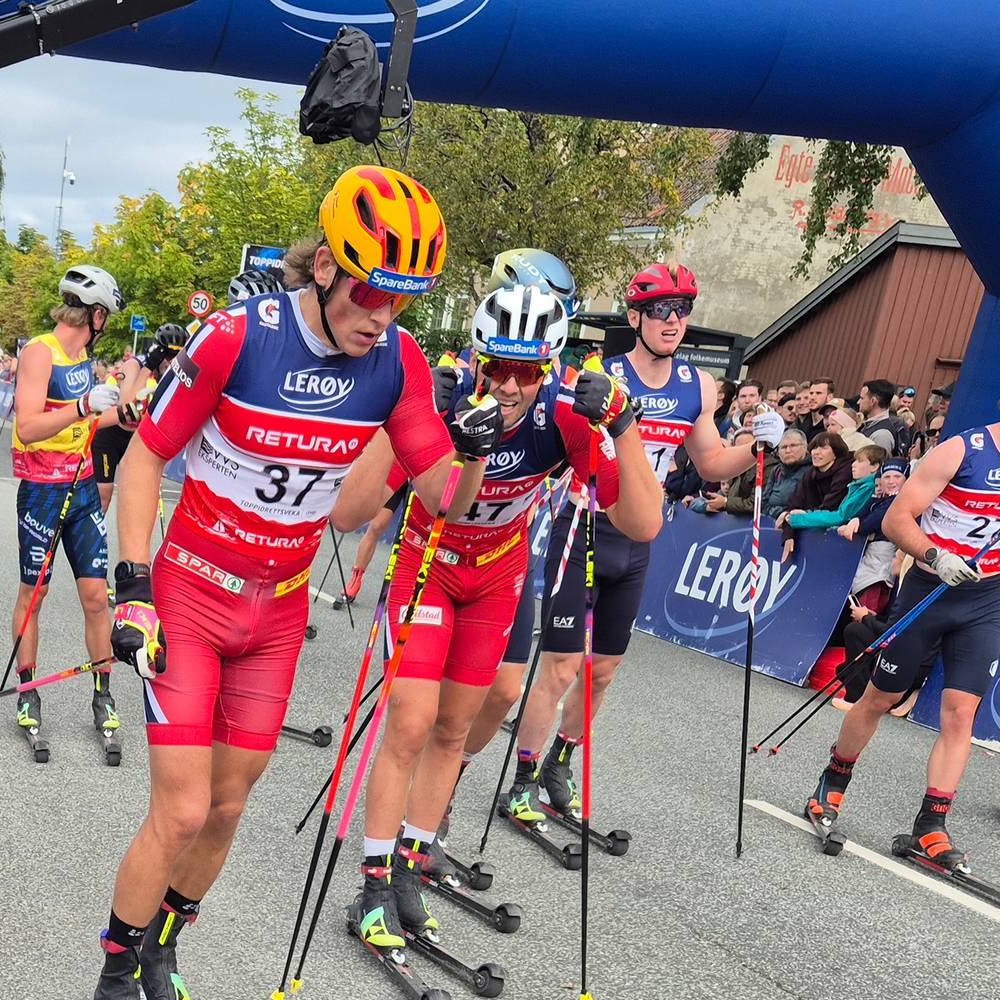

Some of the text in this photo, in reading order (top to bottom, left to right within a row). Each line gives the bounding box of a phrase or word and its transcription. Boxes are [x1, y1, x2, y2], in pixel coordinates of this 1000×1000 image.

[371, 271, 428, 291] SpareBank
[192, 297, 208, 310] 50
[488, 341, 537, 355] SpareBank
[283, 371, 350, 397] LERØY
[641, 397, 677, 411] ERØY
[246, 425, 349, 455] RETURA
[254, 464, 328, 507] 37
[463, 502, 514, 521] 47
[234, 528, 300, 548] RETURA
[175, 551, 226, 583] SPAR
[674, 541, 797, 615] LERØY
[553, 616, 575, 627] EA7
[880, 658, 898, 673] EA7
